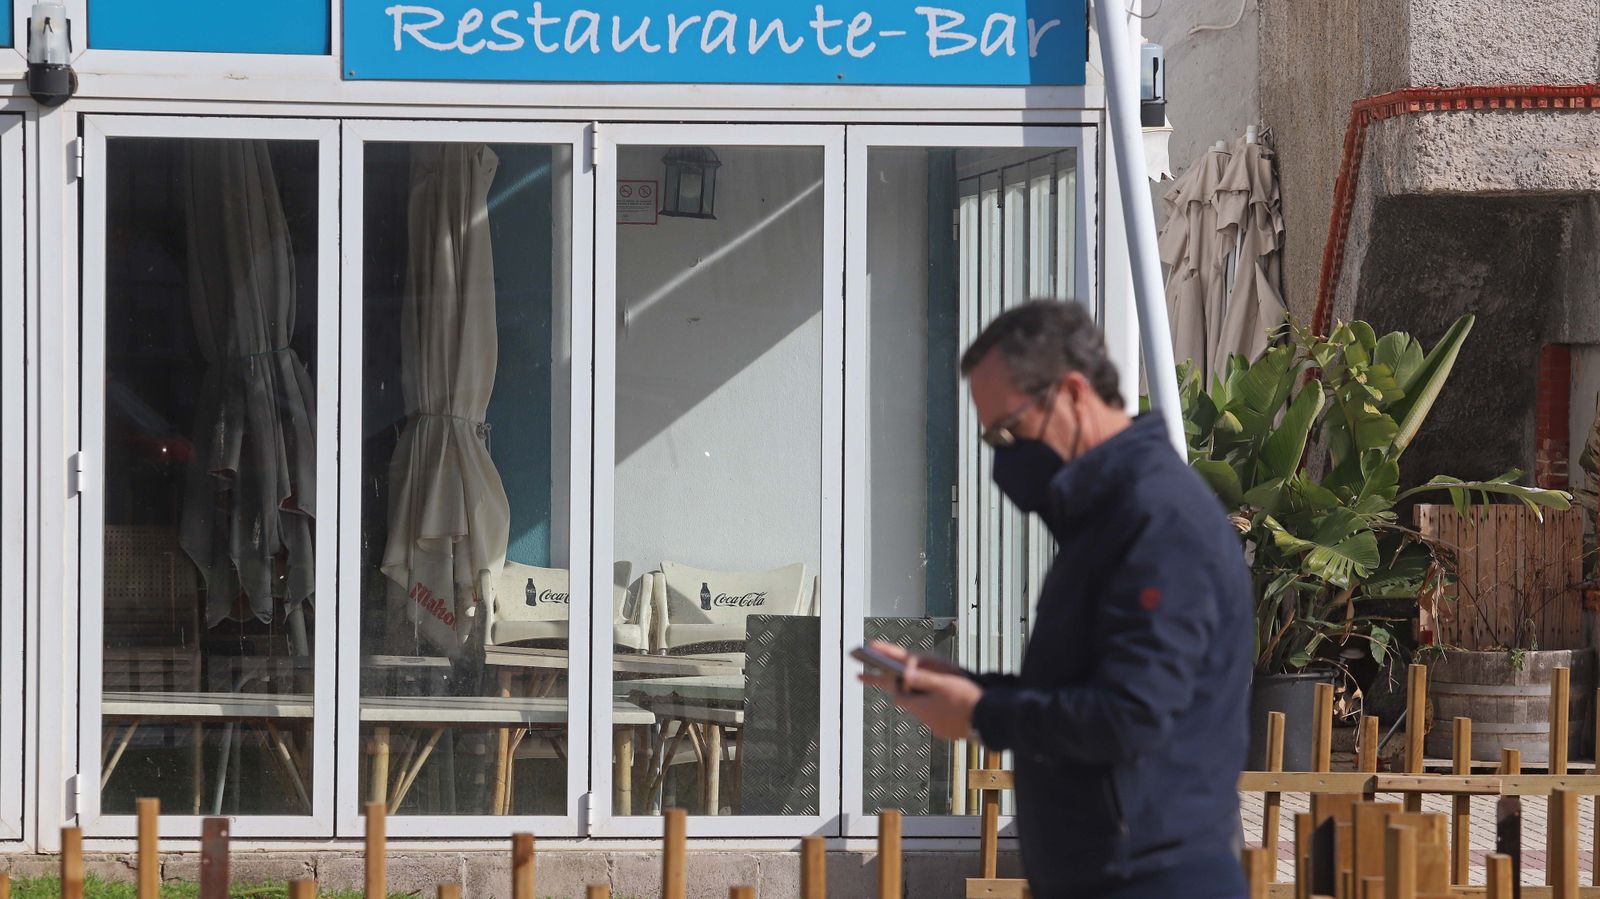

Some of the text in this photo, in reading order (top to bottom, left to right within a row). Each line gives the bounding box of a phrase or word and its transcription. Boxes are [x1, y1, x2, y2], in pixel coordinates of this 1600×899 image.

[385, 2, 1063, 58] Restaurante-Bar
[409, 582, 457, 632] Maho
[713, 591, 768, 608] Coca-Cola
